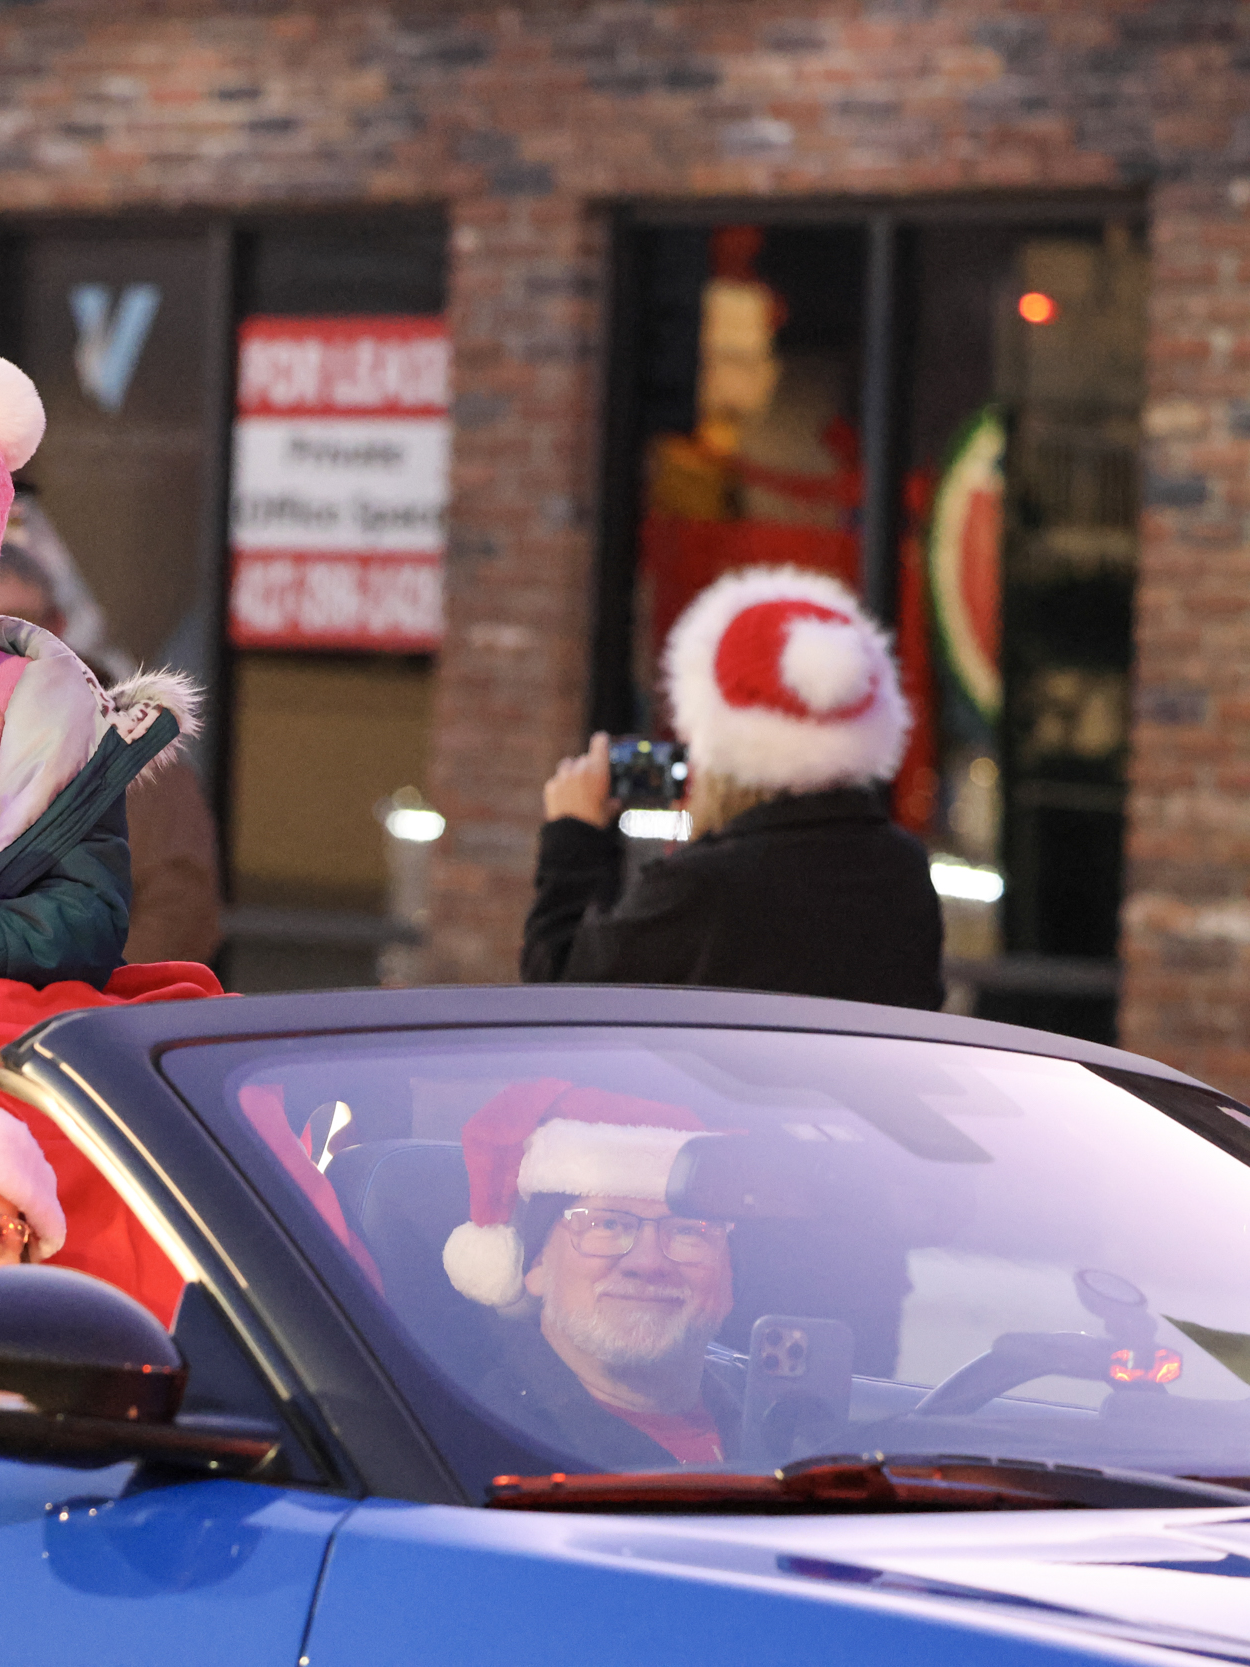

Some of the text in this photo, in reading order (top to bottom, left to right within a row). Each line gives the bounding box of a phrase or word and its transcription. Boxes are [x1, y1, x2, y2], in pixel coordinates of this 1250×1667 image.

[240, 337, 447, 405] FOR LEASE
[285, 434, 406, 468] Private
